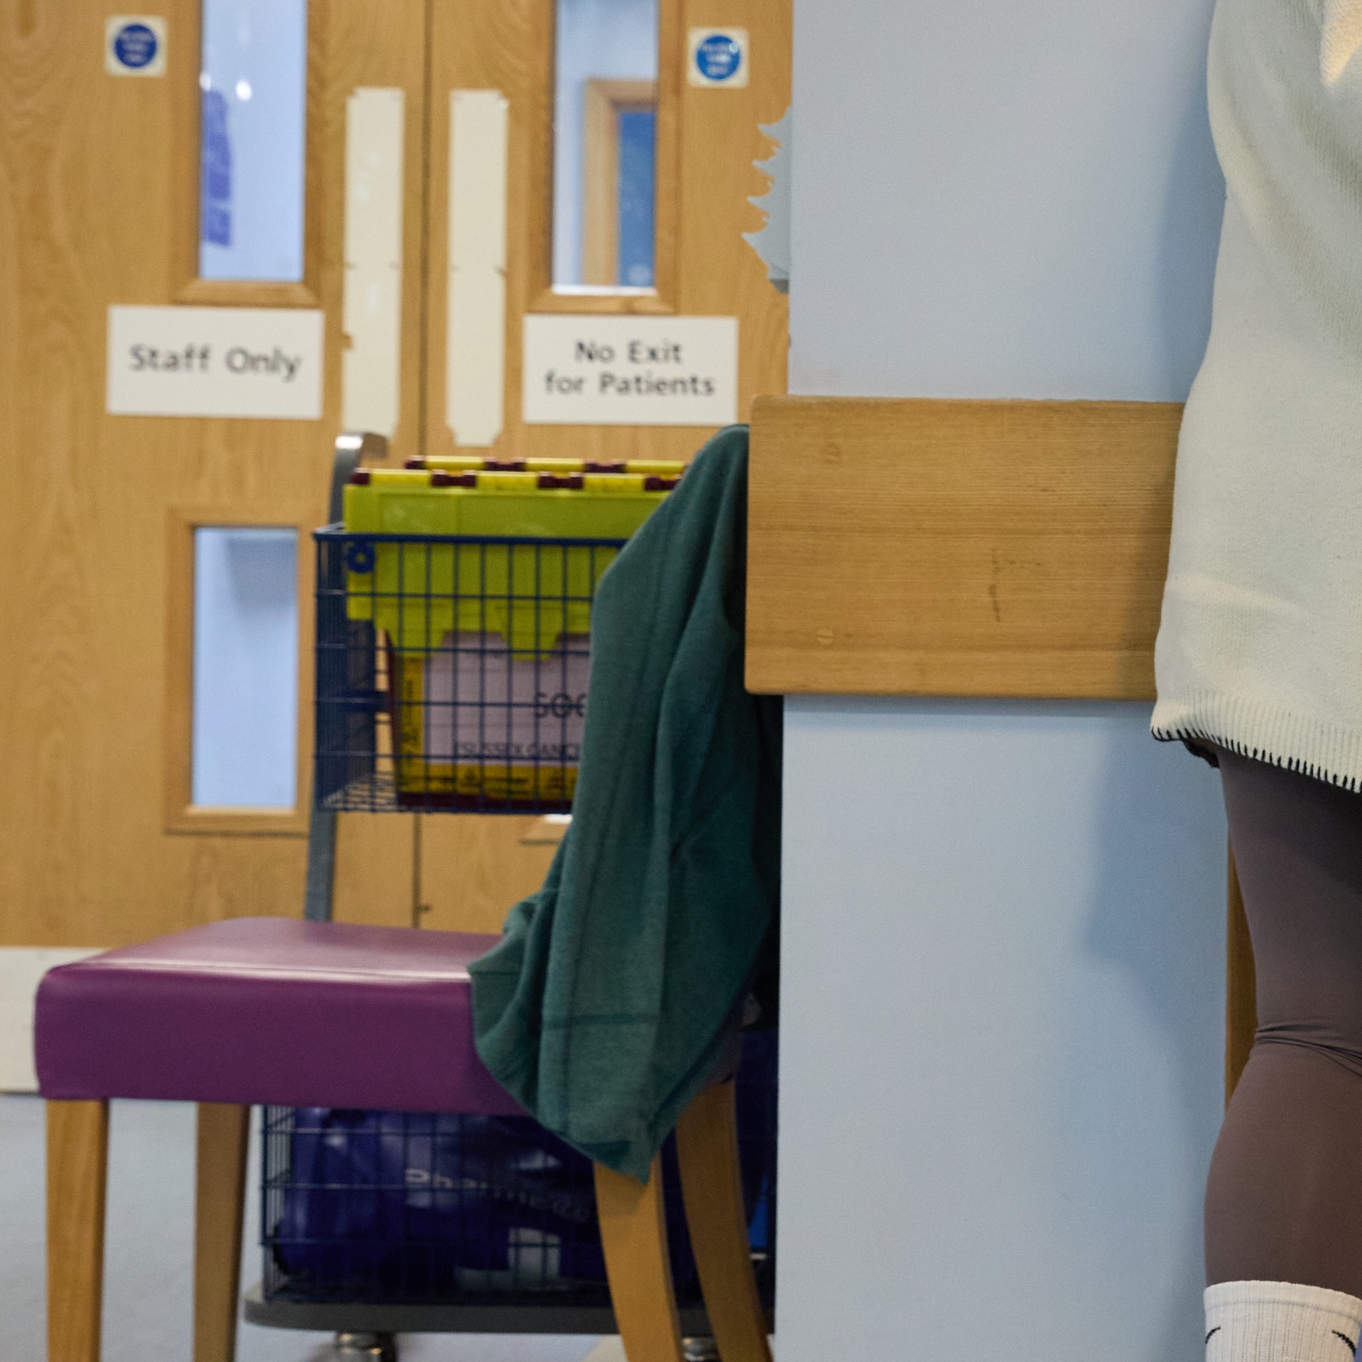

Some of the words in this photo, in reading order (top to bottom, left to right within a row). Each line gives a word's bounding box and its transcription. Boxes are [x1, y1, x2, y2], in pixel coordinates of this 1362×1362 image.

[129, 344, 210, 372] Staff
[225, 346, 302, 383] Only
[575, 340, 616, 363] No
[628, 340, 682, 363] Exit
[545, 370, 584, 395] for
[600, 371, 714, 395] Patients
